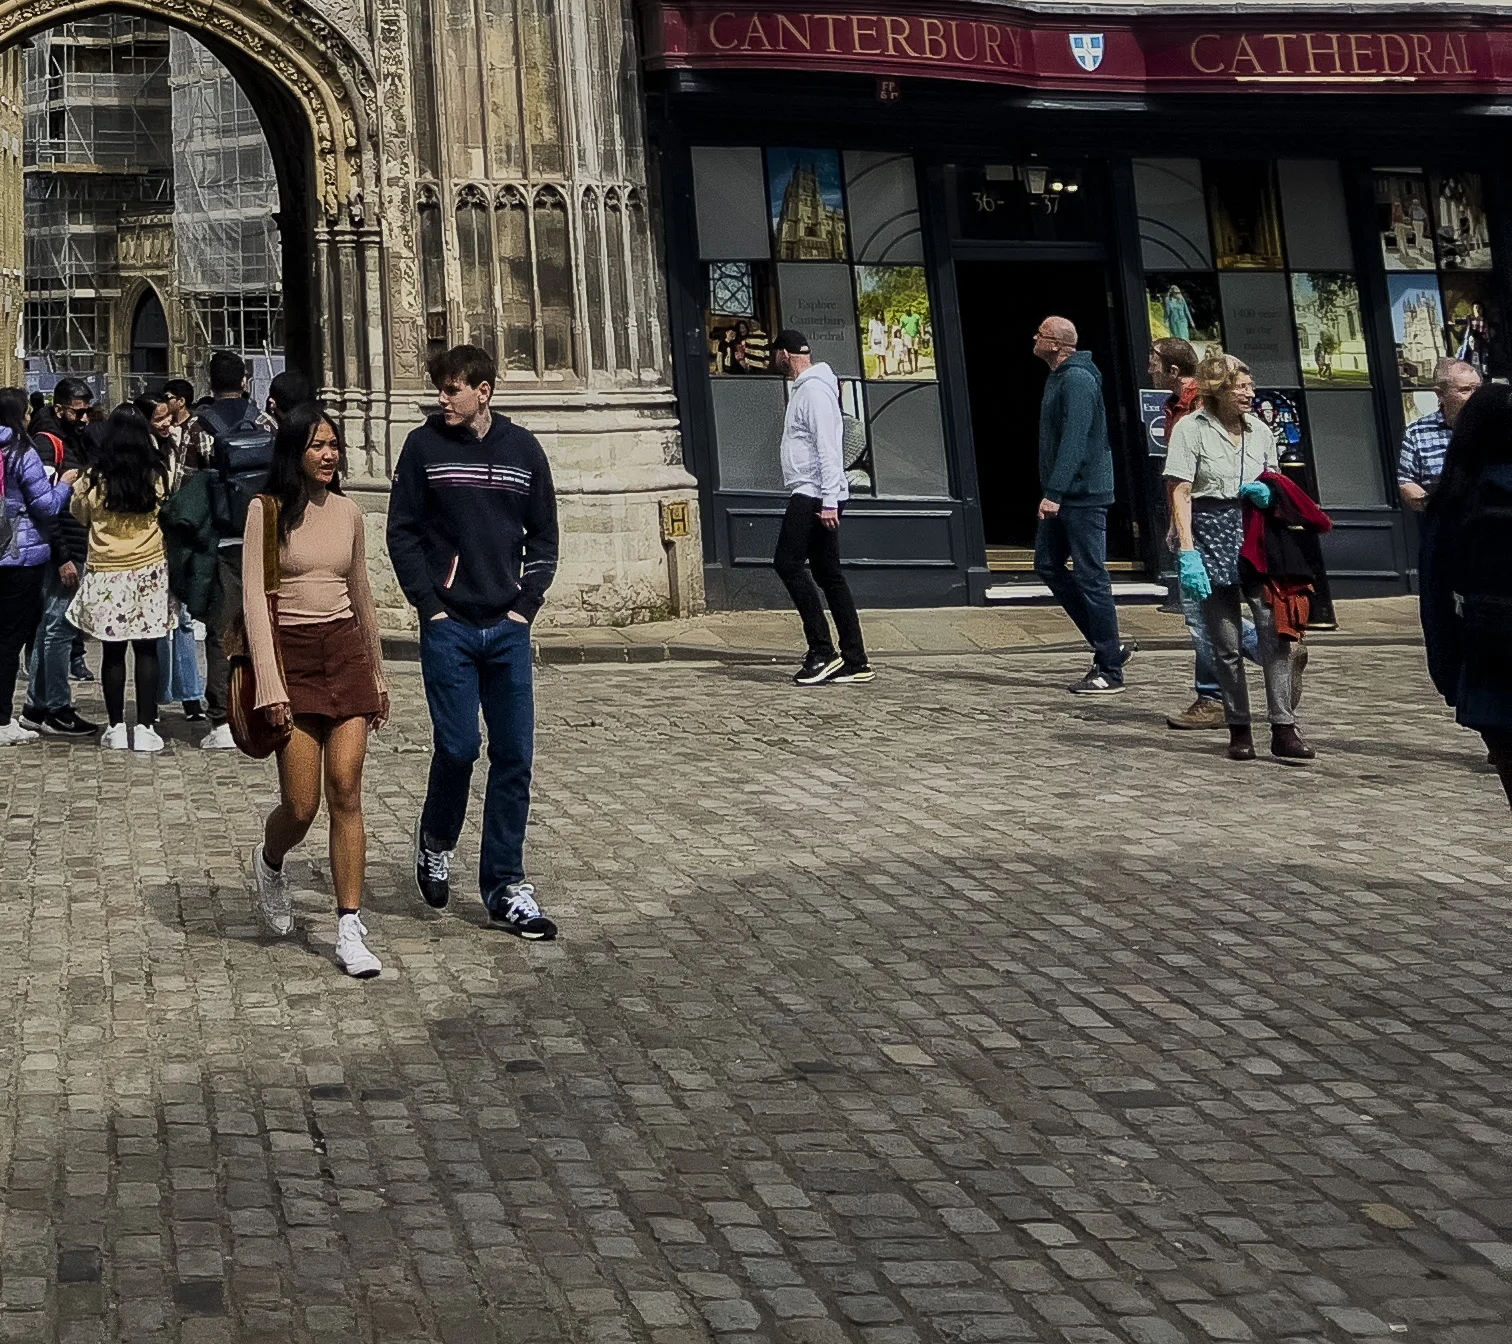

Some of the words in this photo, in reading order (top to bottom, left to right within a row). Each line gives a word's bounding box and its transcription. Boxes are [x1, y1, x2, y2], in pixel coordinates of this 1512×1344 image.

[708, 11, 1023, 66] CANTERBURY
[1190, 33, 1477, 74] CATHEDRAL
[670, 506, 687, 533] H
